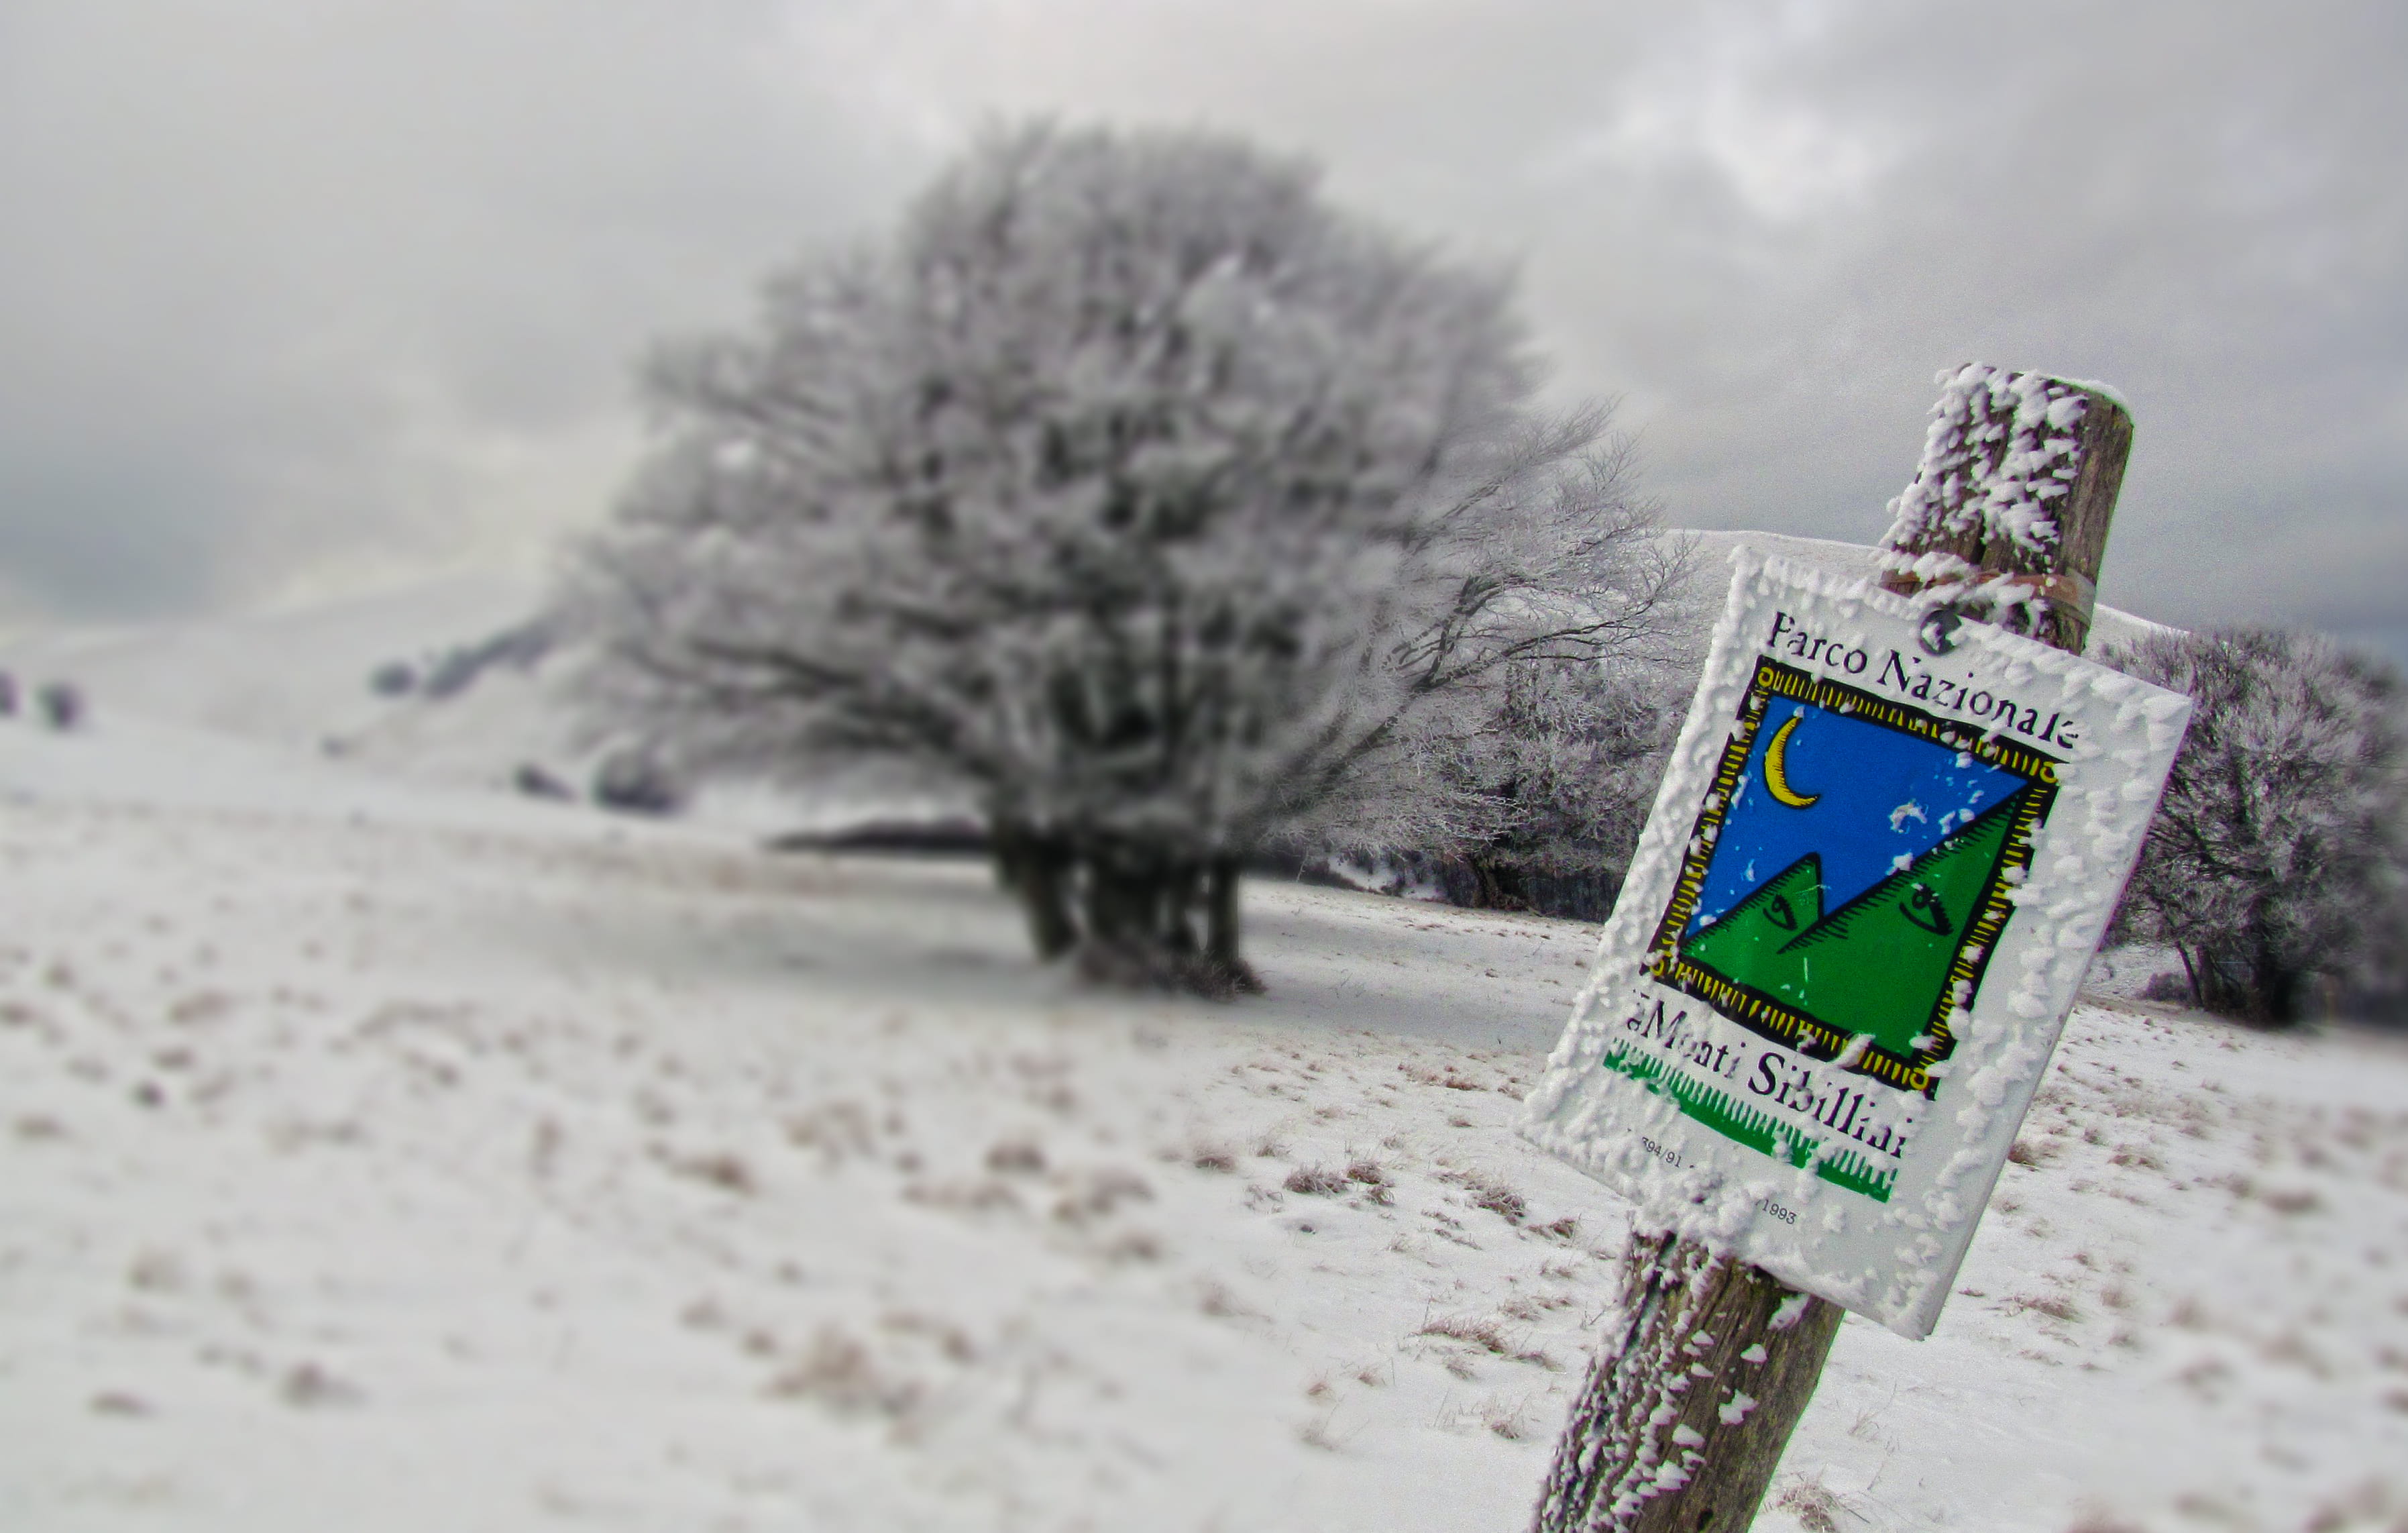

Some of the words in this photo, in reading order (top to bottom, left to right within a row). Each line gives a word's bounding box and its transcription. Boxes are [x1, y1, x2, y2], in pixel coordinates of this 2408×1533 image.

[1766, 611, 1868, 674] Parco
[1877, 649, 2079, 749] Nazionale
[1747, 1051, 1912, 1159] Sibillini
